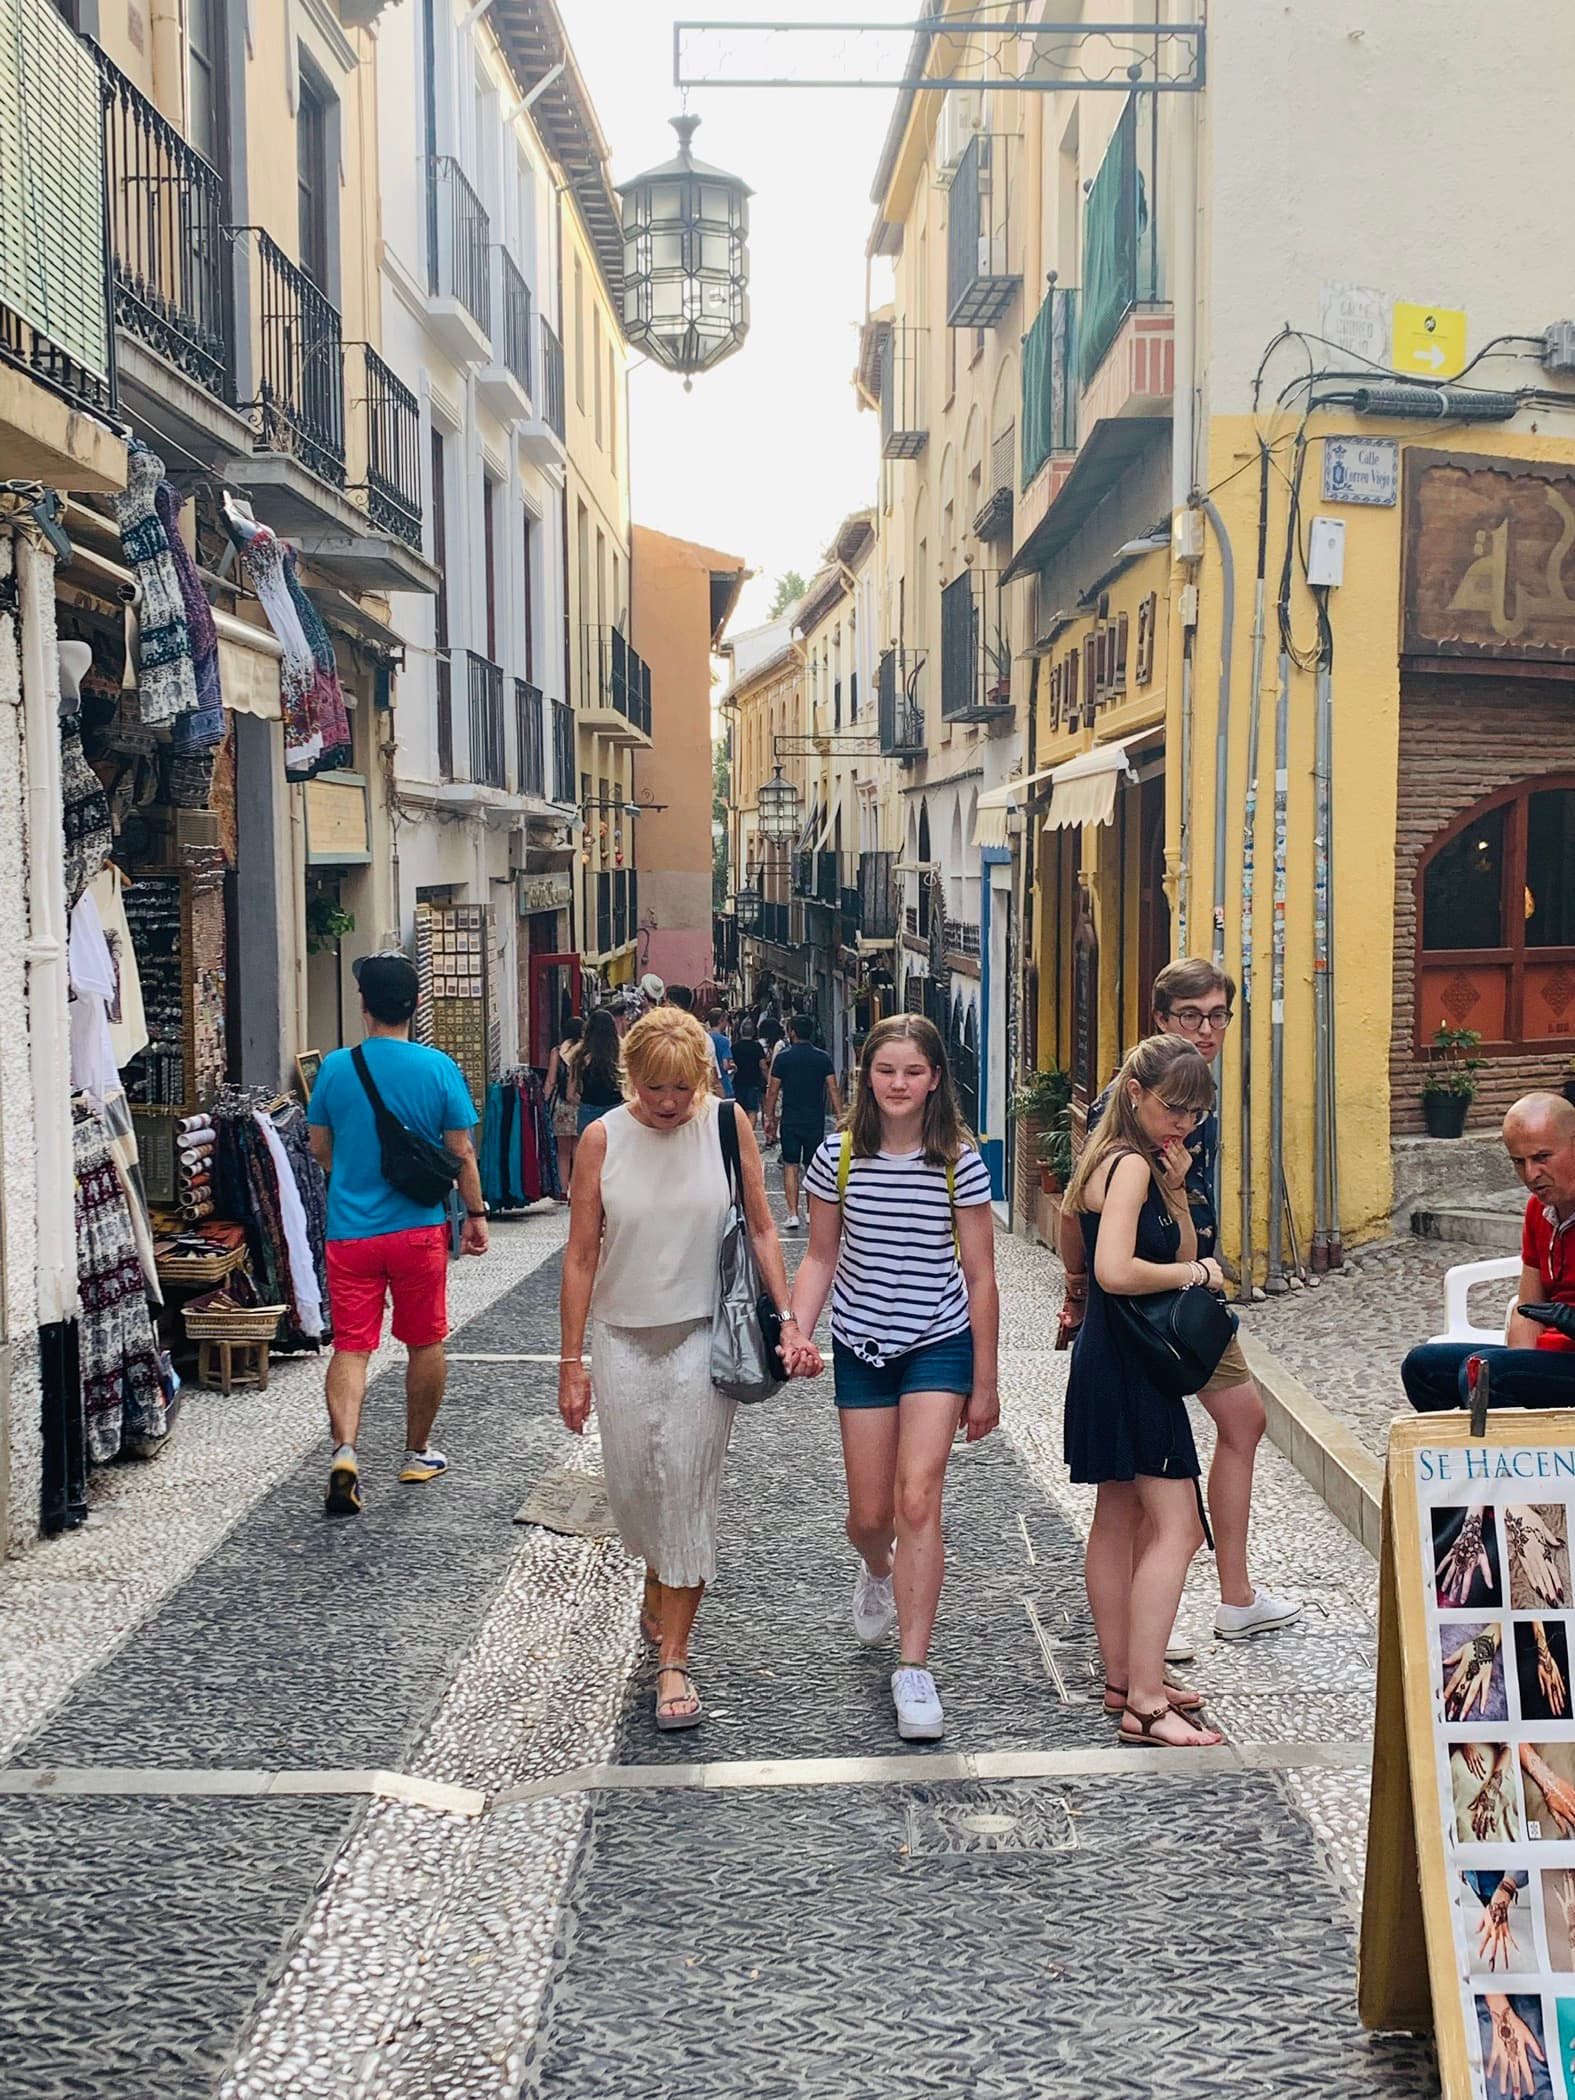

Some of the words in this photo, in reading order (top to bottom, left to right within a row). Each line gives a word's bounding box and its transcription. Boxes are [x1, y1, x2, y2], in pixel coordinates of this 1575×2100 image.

[1358, 450, 1380, 465] Calle
[1420, 1449, 1452, 1481] SE
[1465, 1449, 1575, 1479] HACEN
